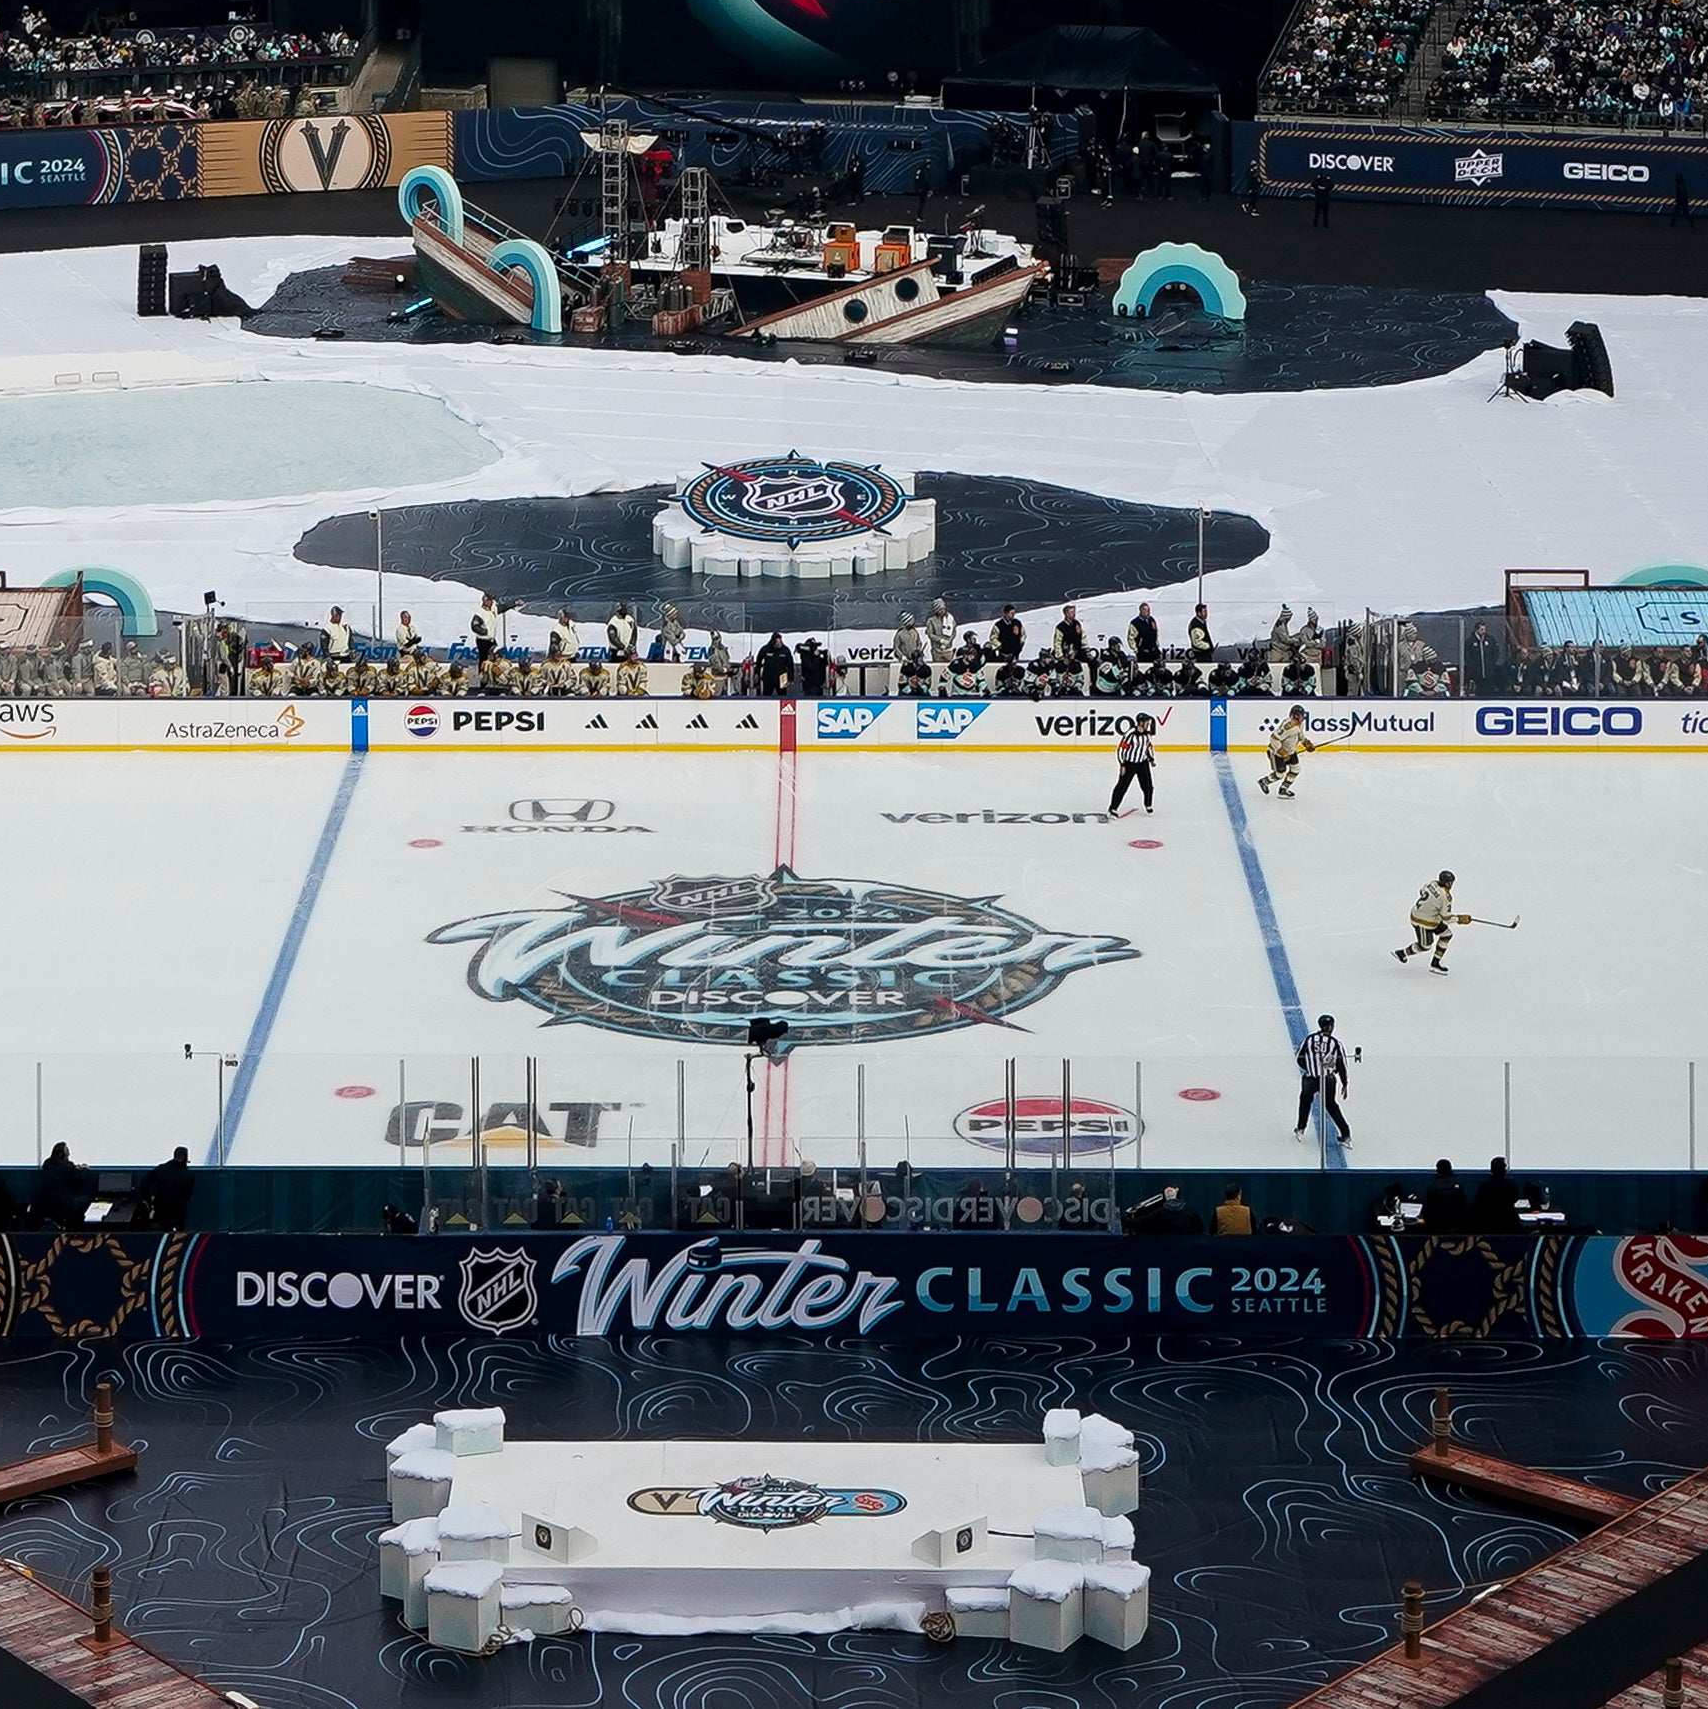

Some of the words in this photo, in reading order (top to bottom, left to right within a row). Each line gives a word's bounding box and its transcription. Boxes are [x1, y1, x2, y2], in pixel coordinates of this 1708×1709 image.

[40, 157, 85, 174] 2024
[1309, 152, 1395, 173] DISCOVER
[1563, 163, 1650, 183] GEICO
[40, 172, 86, 185] SEATTLE
[766, 483, 826, 509] NHL
[165, 720, 279, 739] AstraZeneca
[406, 716, 440, 727] PEPSI
[453, 711, 545, 732] PEPSI
[818, 707, 875, 736] SAP
[918, 707, 975, 736] SAP
[1475, 706, 1643, 736] GEICO
[881, 810, 1110, 824] verizon
[461, 824, 654, 834] HONDA
[679, 882, 756, 905] NHL
[424, 906, 1141, 1001] Winter
[602, 967, 958, 990] CLASSIC
[650, 991, 906, 1008] DISCOVER
[385, 1099, 622, 1149] CAT
[969, 1117, 1132, 1135] PEPSI
[236, 1271, 443, 1309] DISCOVER
[476, 1261, 527, 1317] NHL
[552, 1234, 905, 1336] Winter
[917, 1267, 1215, 1313] CLASSIC
[1231, 1268, 1325, 1295] 2024
[1232, 1297, 1328, 1313] SEATTLE
[686, 1489, 849, 1516] Winter
[727, 1505, 812, 1513] CLASSIC
